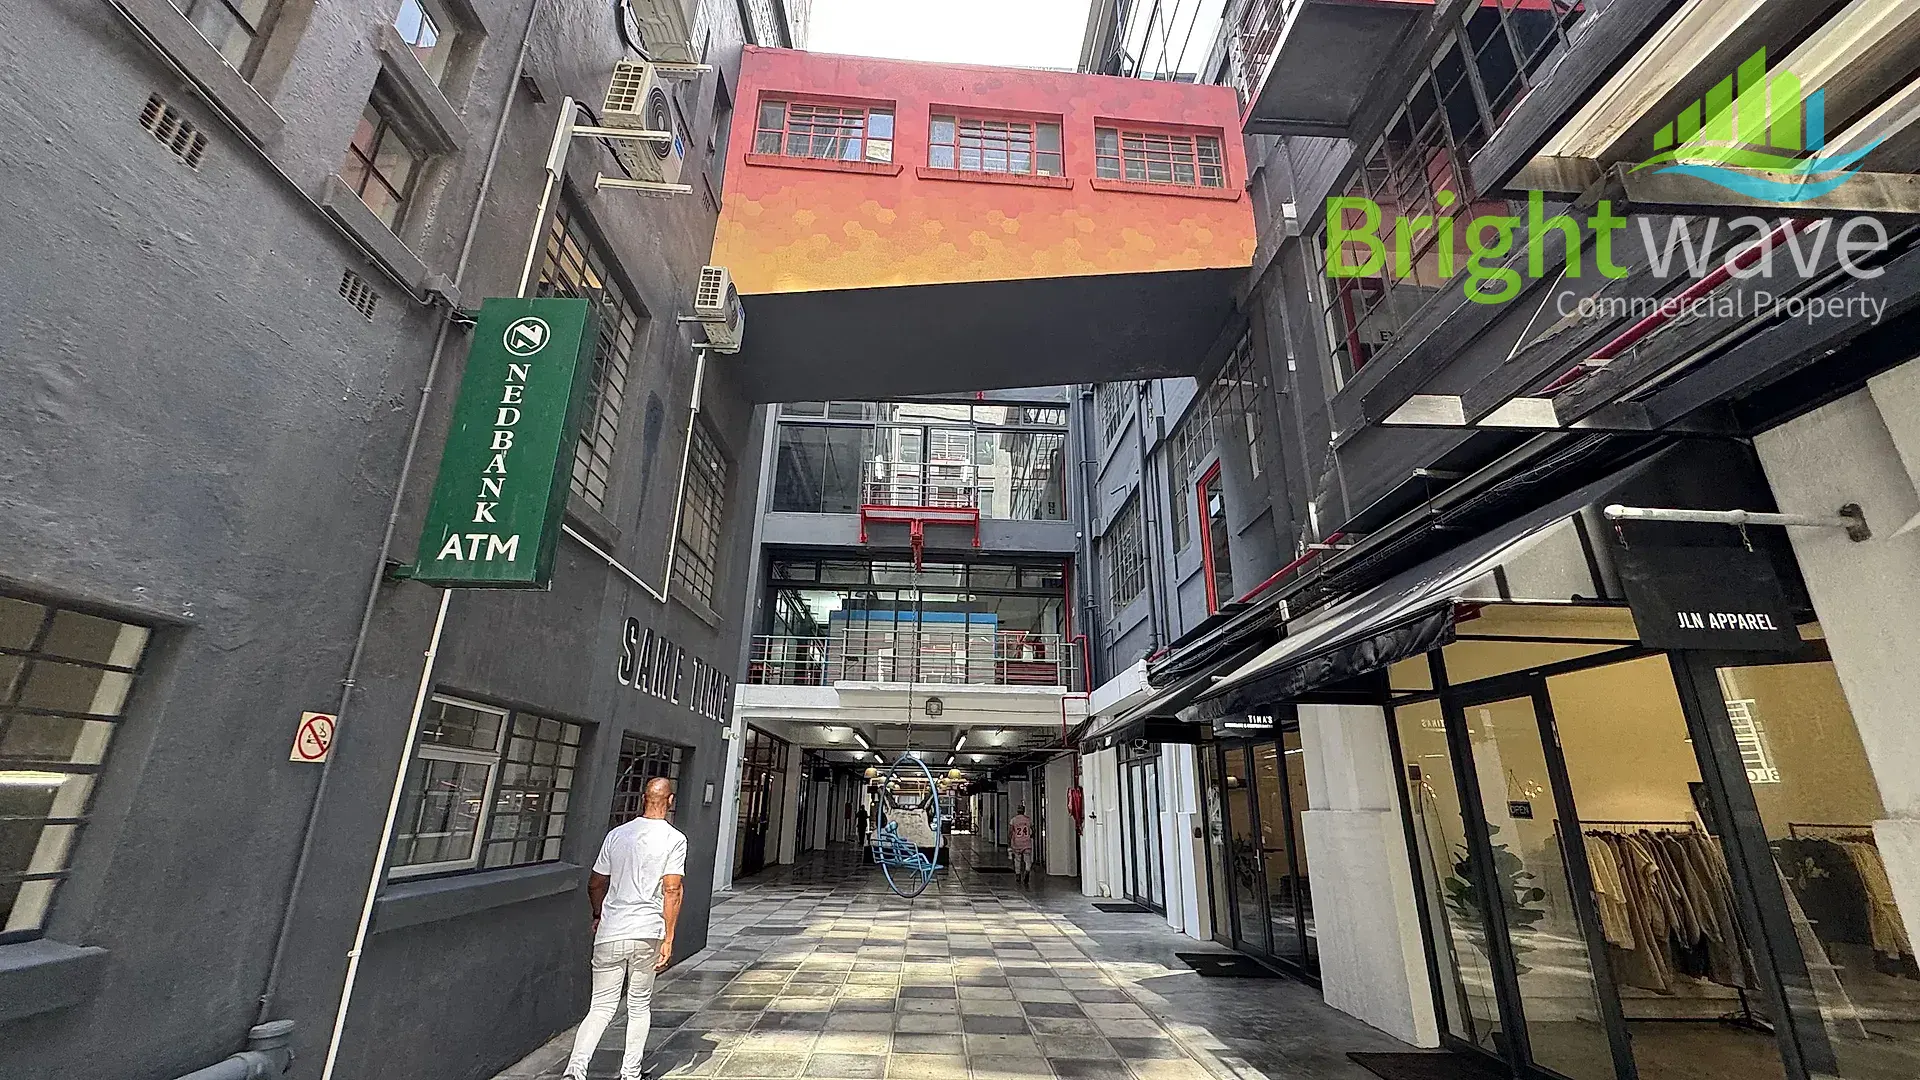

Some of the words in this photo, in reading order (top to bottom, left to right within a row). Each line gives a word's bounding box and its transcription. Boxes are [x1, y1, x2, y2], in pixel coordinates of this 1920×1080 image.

[472, 363, 531, 523] NEDBANK
[436, 533, 520, 562] ATM
[1677, 611, 1704, 629] JLN
[1708, 612, 1778, 631] APPAREL
[617, 616, 685, 705] SAME
[690, 656, 730, 723] TIME
[1510, 805, 1529, 815] OPEN
[1016, 826, 1028, 836] 24
